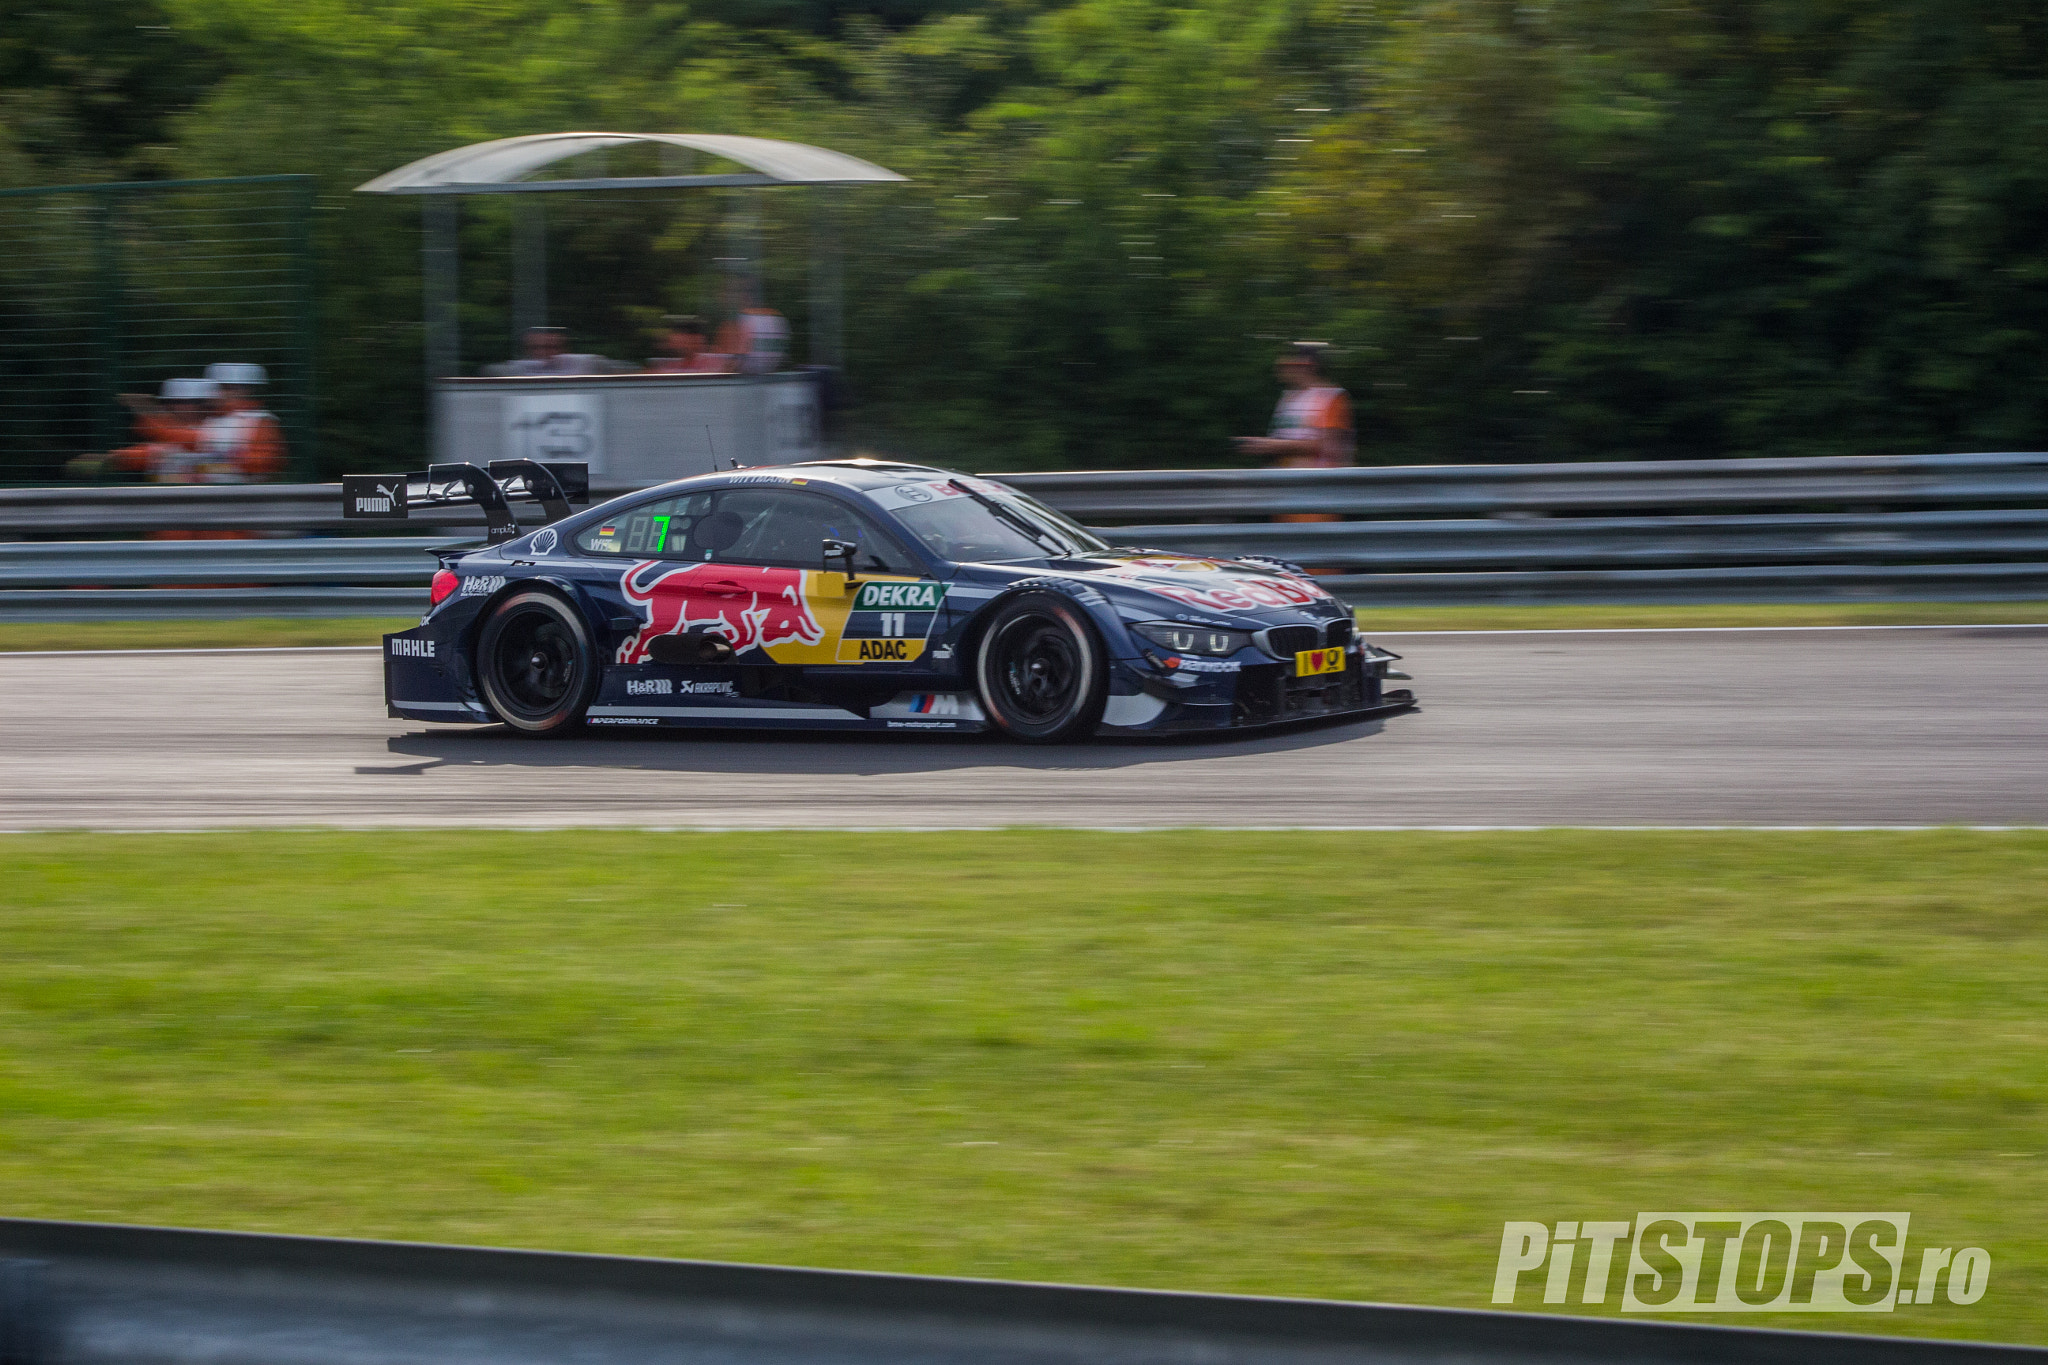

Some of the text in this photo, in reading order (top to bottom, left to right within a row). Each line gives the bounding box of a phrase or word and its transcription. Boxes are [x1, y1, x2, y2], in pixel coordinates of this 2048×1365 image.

[356, 498, 390, 513] PUMA
[863, 585, 936, 606] DEKRA
[880, 613, 905, 637] 11
[391, 638, 435, 657] MAHLE
[859, 640, 908, 660] ADAC
